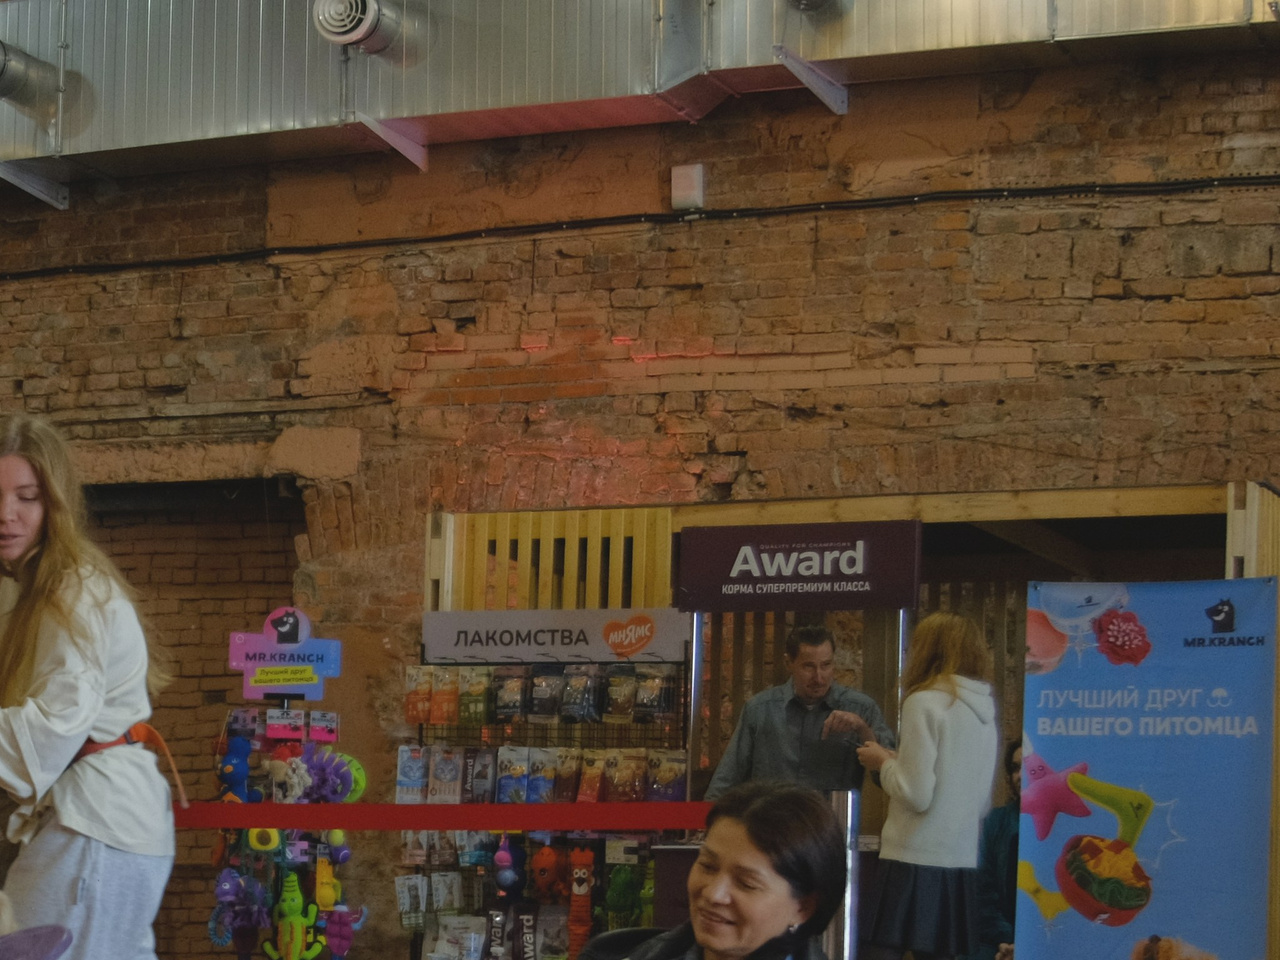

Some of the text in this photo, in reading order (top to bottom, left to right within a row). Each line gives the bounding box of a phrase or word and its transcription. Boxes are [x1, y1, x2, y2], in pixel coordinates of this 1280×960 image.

[729, 540, 864, 577] Award
[722, 581, 871, 594] КОРМА СУПЕРПРЕМИУМ КЛАССА
[454, 629, 589, 647] ЛАКОМСТВА
[1183, 636, 1265, 648] MR.KRANCH
[245, 652, 324, 664] MR.KRANCH
[1037, 685, 1203, 711] ЛУЧШИЙ ДРУГ
[1037, 716, 1258, 738] ВАШЕГО ПИТОМЦА
[464, 759, 473, 791] Award
